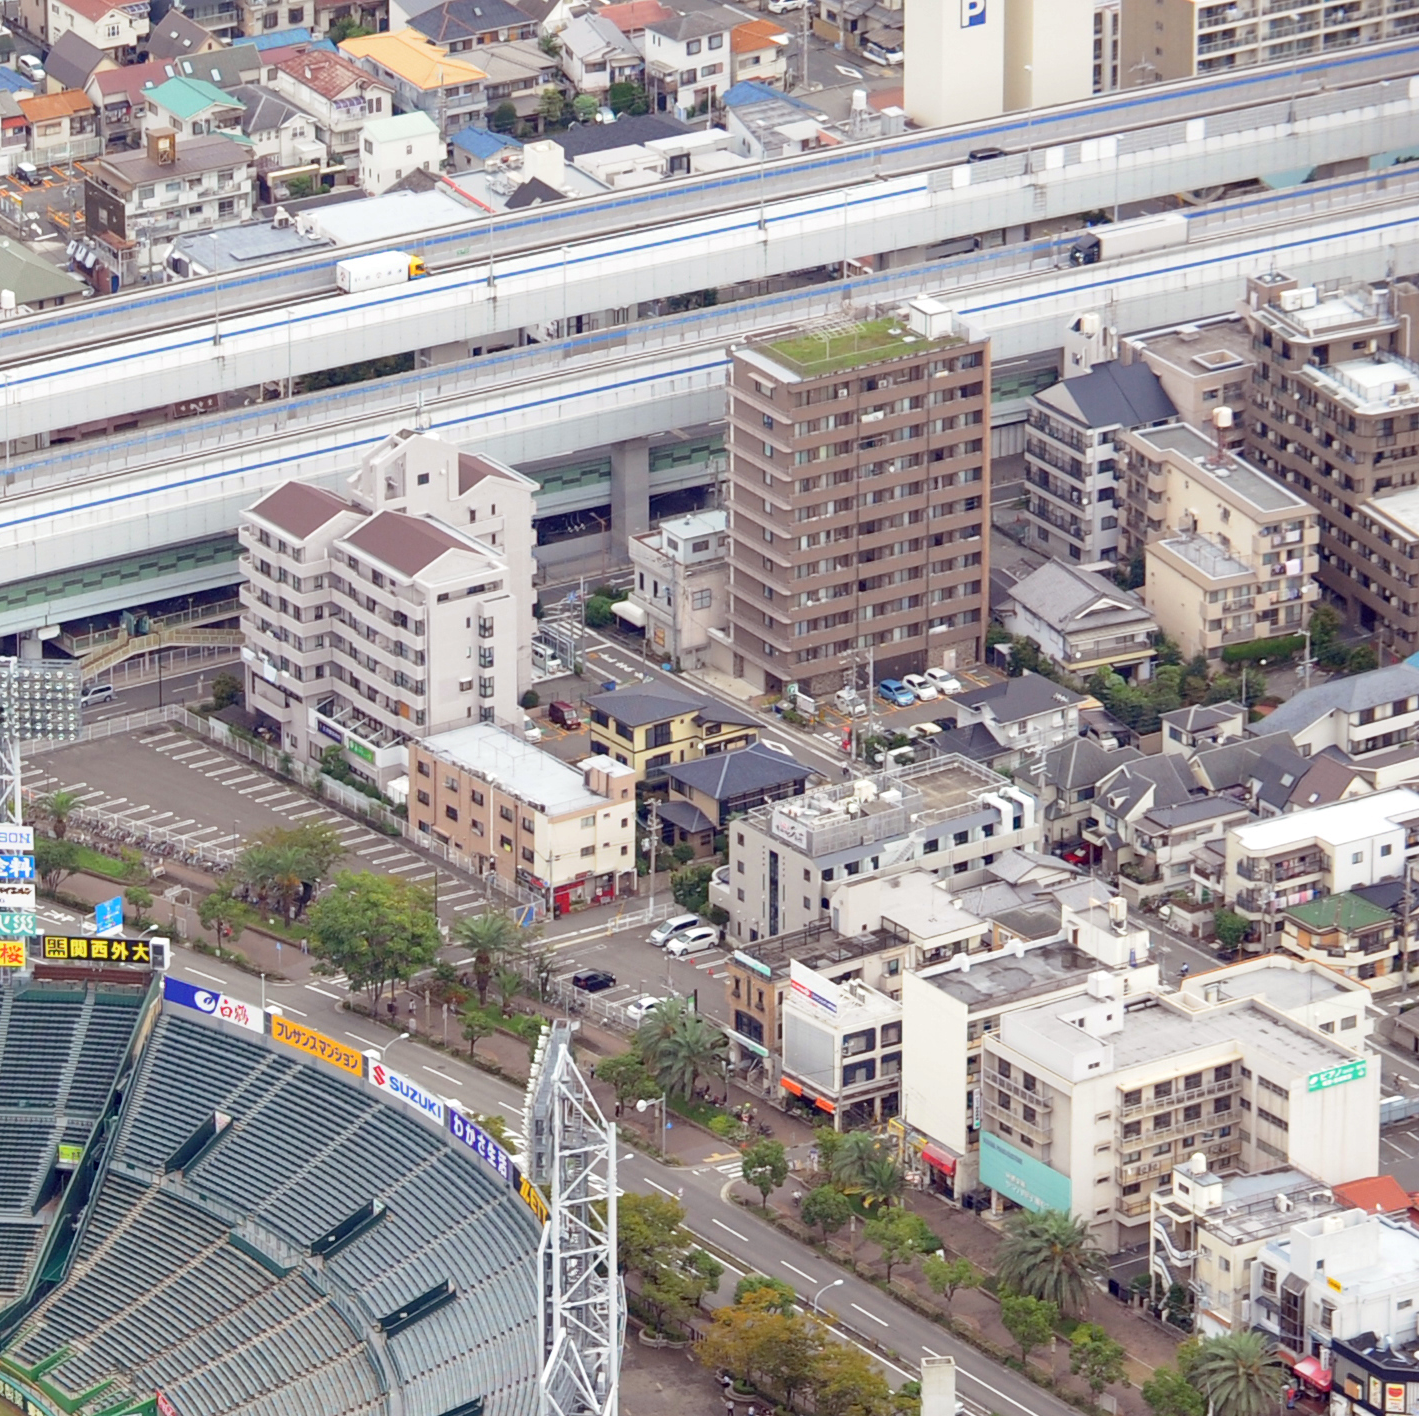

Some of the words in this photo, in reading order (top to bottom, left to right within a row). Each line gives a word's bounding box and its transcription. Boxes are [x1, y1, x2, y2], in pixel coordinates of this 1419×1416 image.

[963, 0, 984, 26] P
[70, 939, 150, 961] 関西外大
[276, 1021, 359, 1070] プレサンスマンション
[389, 1075, 442, 1119] SUZUKI
[453, 1113, 508, 1180] わかさ生活
